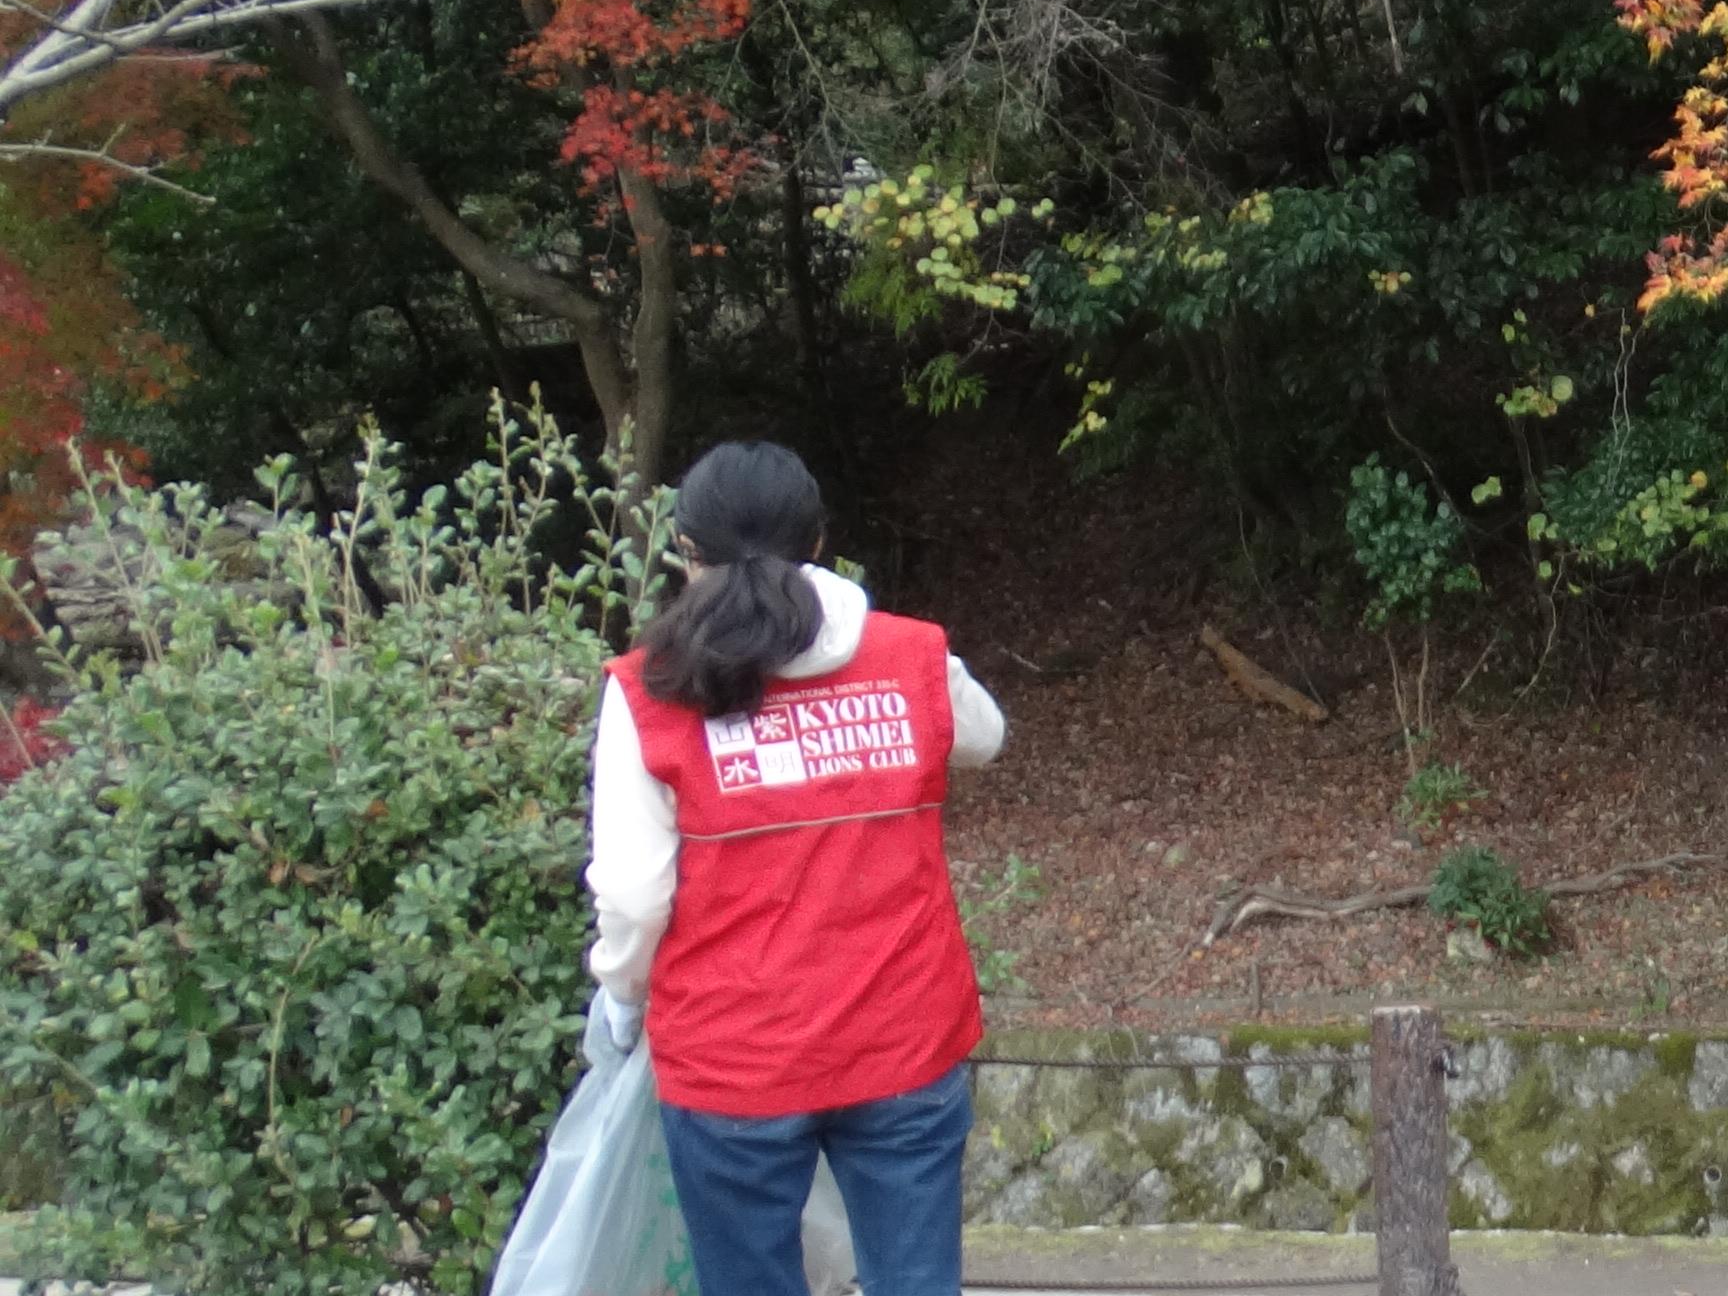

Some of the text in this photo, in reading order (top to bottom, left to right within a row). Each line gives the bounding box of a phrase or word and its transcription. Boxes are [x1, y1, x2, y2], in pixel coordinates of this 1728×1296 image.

[796, 692, 906, 729] KYOTO
[800, 720, 913, 757] SHIMEI
[807, 747, 917, 778] LIONS CLUB
